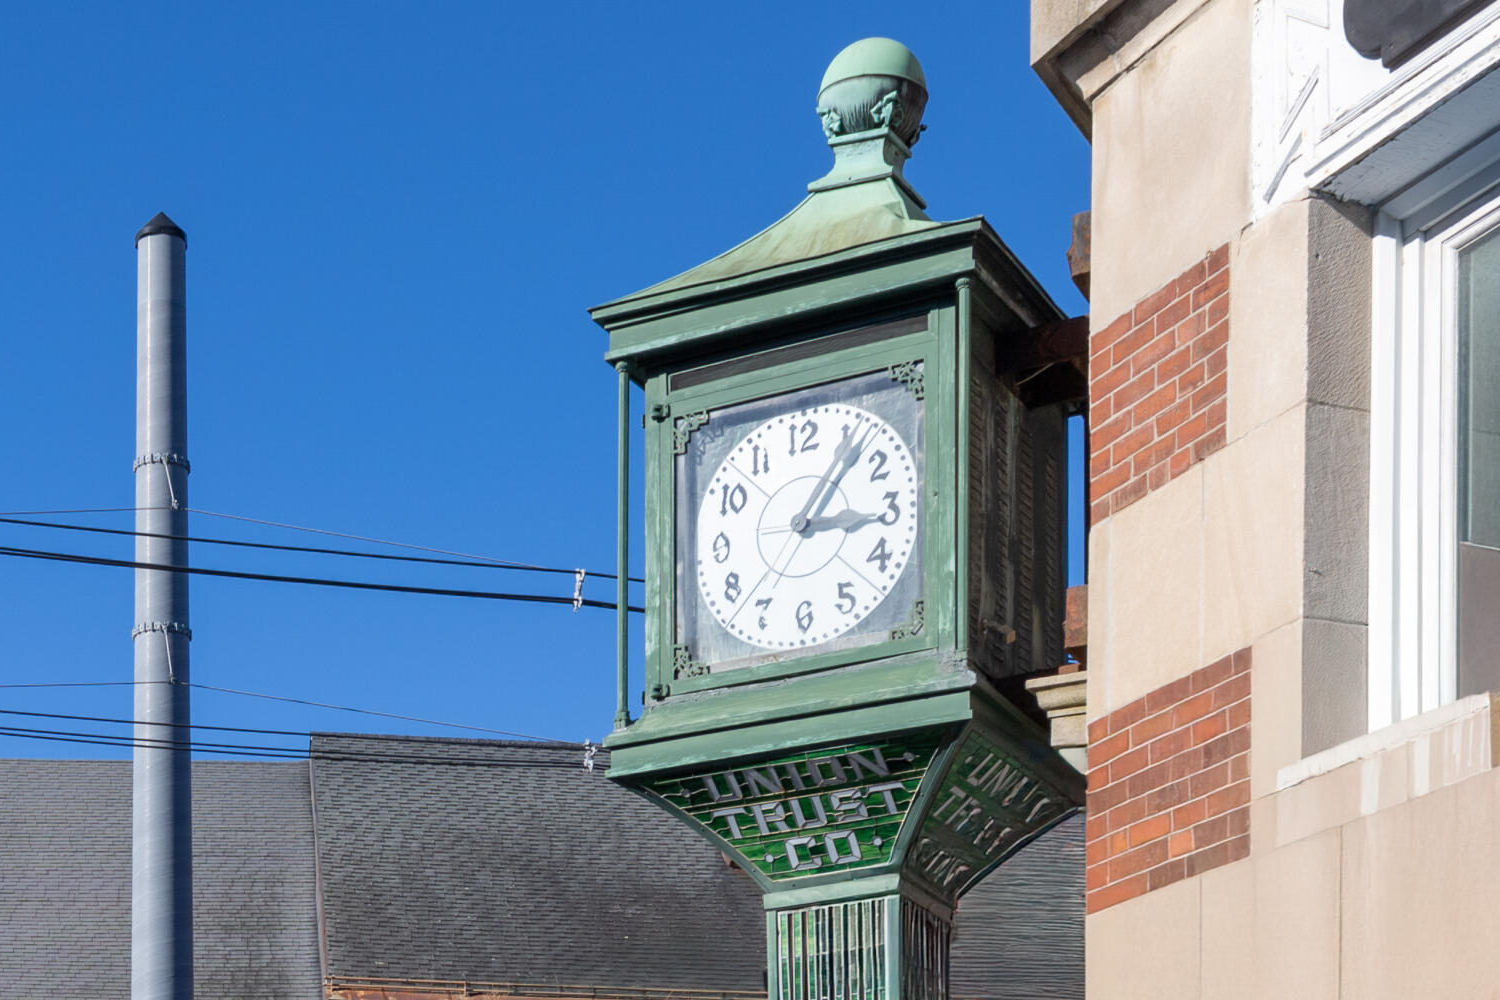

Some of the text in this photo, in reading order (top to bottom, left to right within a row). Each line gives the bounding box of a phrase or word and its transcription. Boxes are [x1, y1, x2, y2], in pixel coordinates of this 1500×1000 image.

[787, 419, 820, 457] 12
[751, 444, 771, 477] 11
[868, 449, 891, 482] 2
[719, 483, 748, 517] 10
[876, 491, 901, 526] 3
[712, 532, 731, 563] 9
[866, 536, 892, 573] 4
[723, 571, 742, 603] 8
[834, 581, 857, 615] 5
[754, 597, 773, 630] 7
[795, 600, 814, 634] 6
[701, 747, 892, 801] UNION
[710, 781, 904, 839] TRUST
[784, 829, 864, 871] CO
